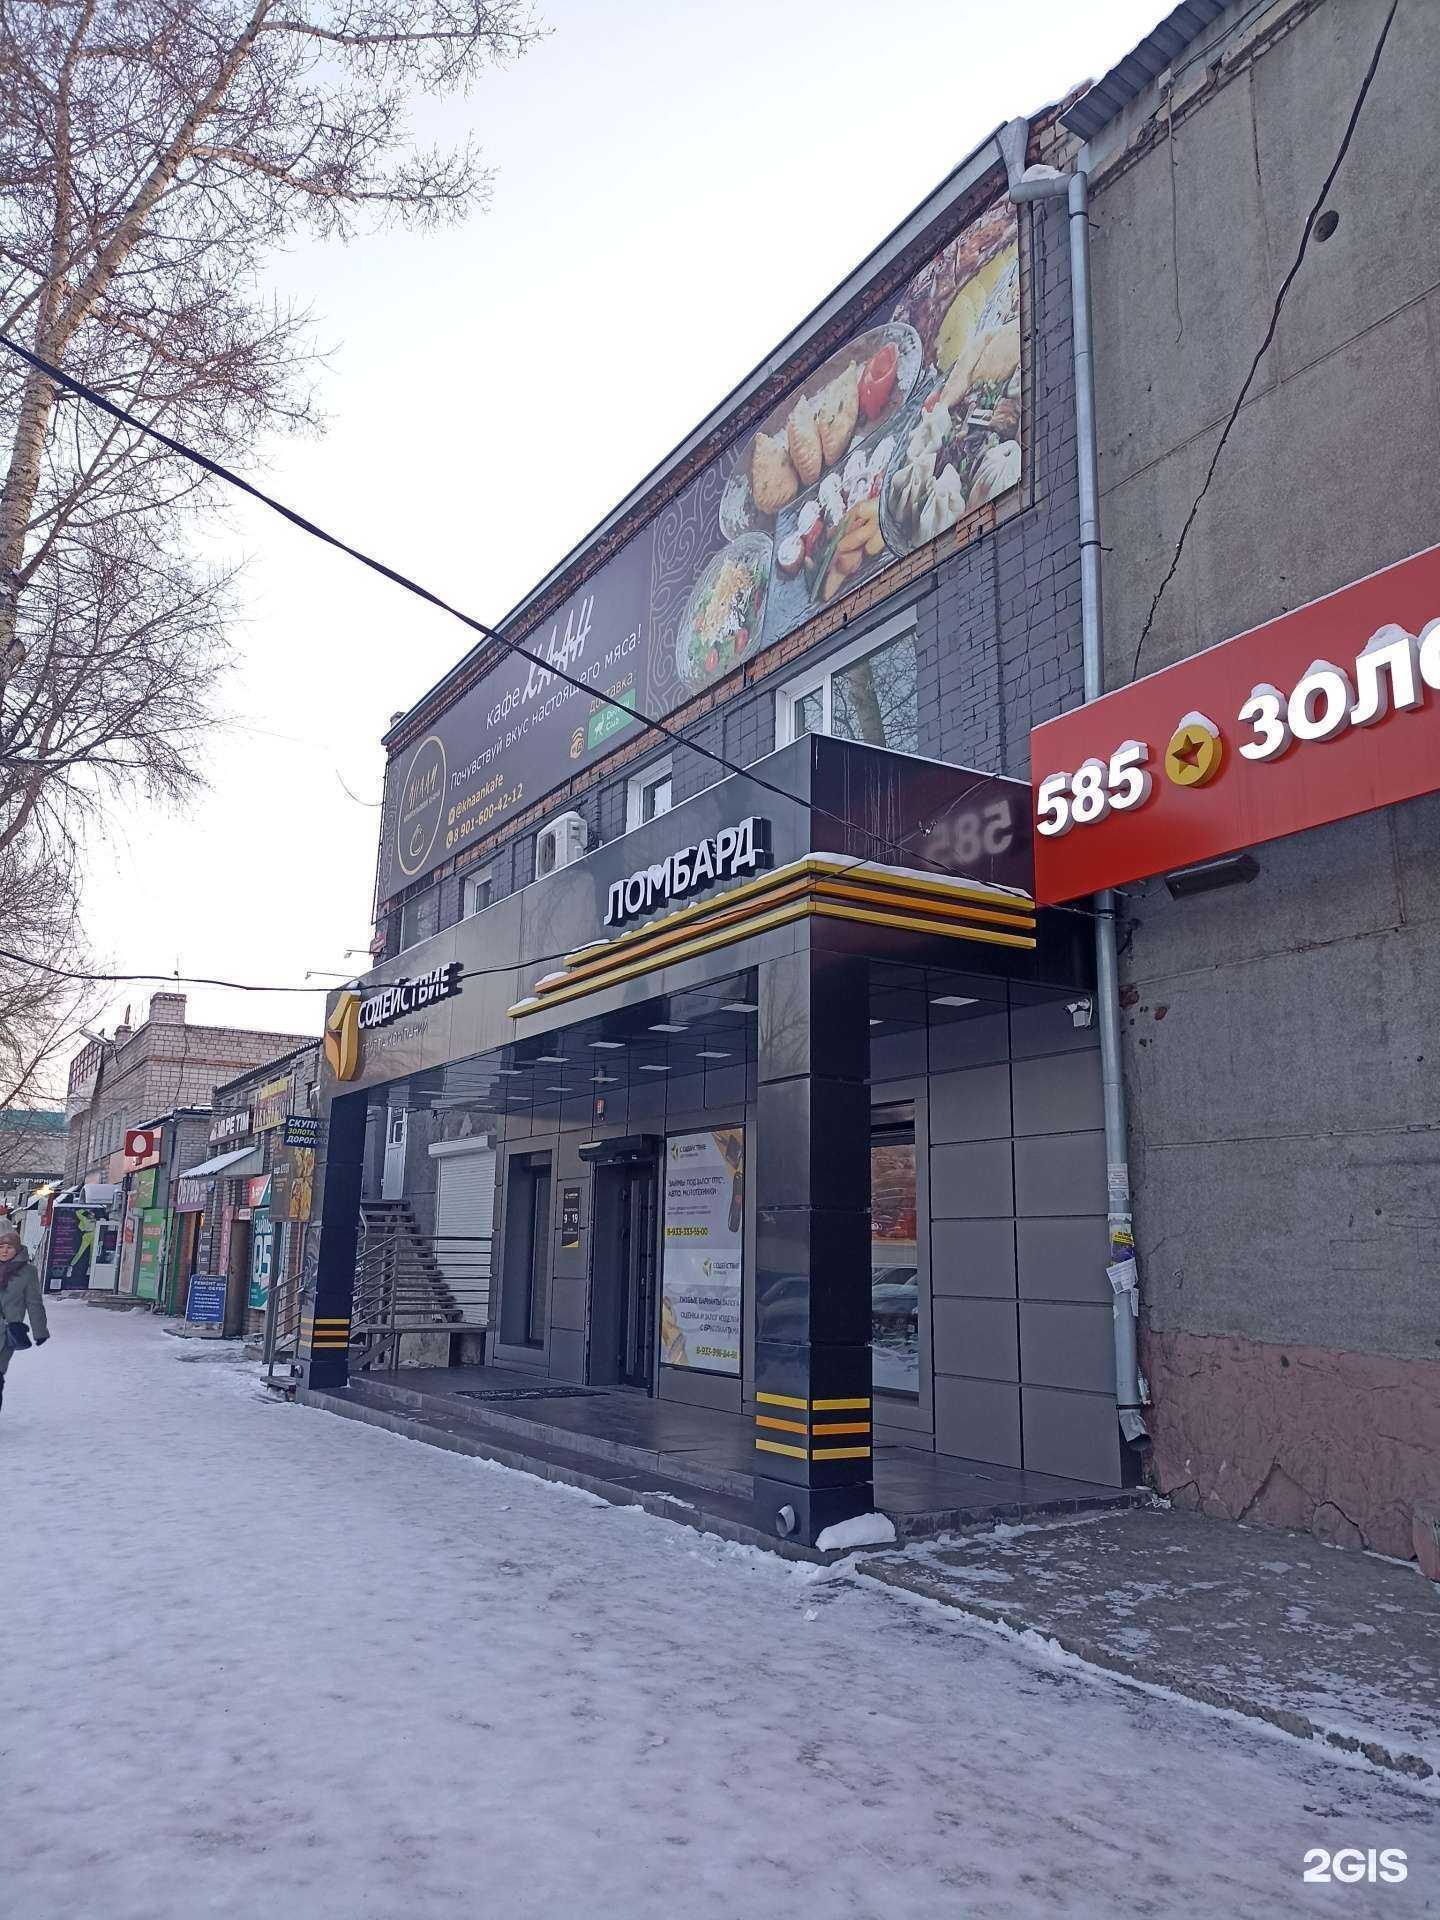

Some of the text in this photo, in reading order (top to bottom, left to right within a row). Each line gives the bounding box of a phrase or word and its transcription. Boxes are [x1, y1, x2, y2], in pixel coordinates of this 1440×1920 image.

[450, 623, 642, 791] Почувствуй вкус настоящего мяса!
[486, 687, 520, 730] кафе
[1036, 741, 1152, 837] 585
[603, 816, 766, 926] ЛОМБАРД
[358, 961, 459, 1029] СОДЕЙСТВИЕ
